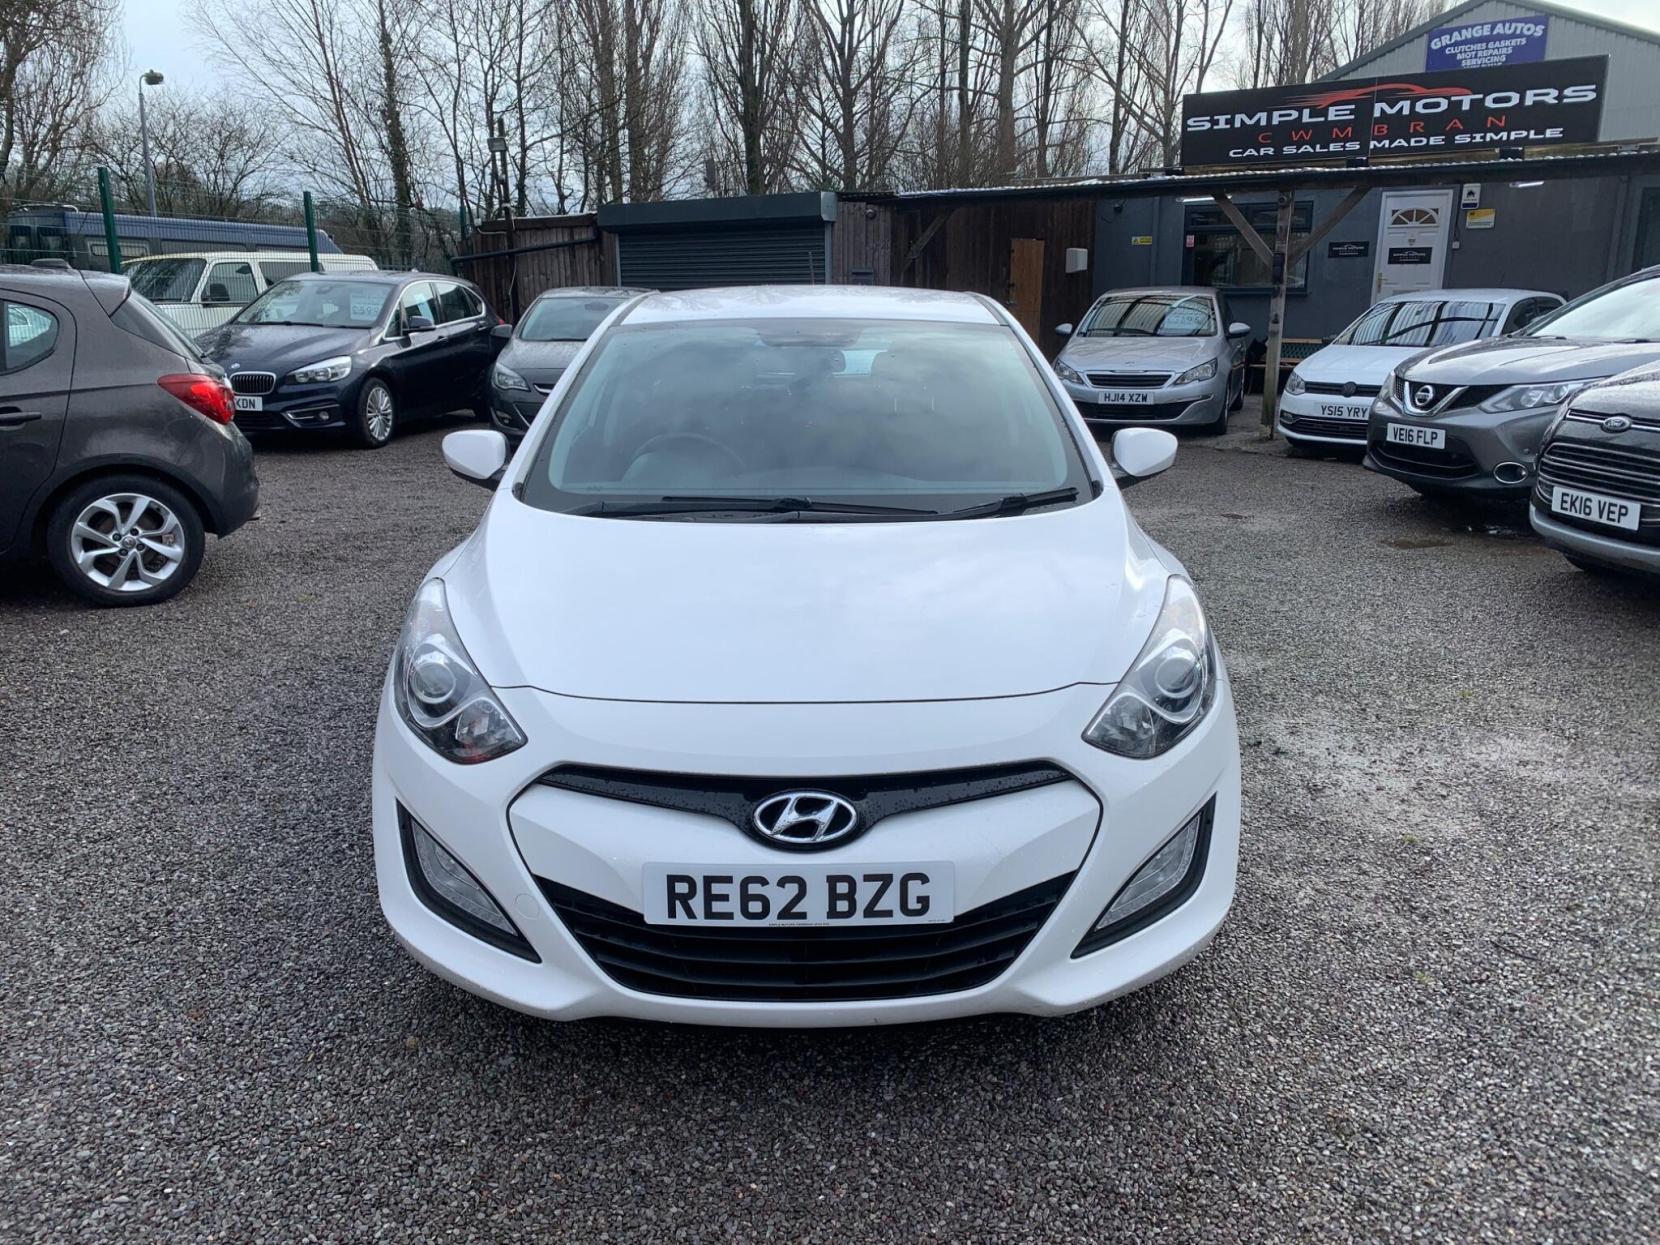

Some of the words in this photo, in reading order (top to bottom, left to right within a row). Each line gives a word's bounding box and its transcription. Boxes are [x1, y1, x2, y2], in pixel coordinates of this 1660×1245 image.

[1430, 24, 1491, 50] GRANGE
[1493, 22, 1546, 37] AUTOS
[1446, 42, 1486, 54] CLUTCHES
[1488, 38, 1527, 48] GASKETS
[1456, 52, 1476, 60] MOT
[1478, 46, 1513, 58] REPAIRS
[1461, 54, 1506, 67] SERVICING
[1186, 104, 1356, 132] SIMPLE
[1374, 84, 1597, 118] MOTORS
[1258, 114, 1506, 144] CWMBRAN
[1229, 146, 1275, 158] CAR
[1282, 141, 1361, 155] SALES
[1370, 136, 1446, 150] MADE
[1454, 128, 1564, 144] SIMPLE
[1104, 393, 1126, 402] HJ14
[1128, 393, 1148, 402] XZW
[1321, 404, 1344, 416] YS15
[1346, 406, 1368, 418] YRY
[1392, 426, 1414, 443] VE16
[1416, 429, 1438, 445] FLP
[1560, 492, 1593, 516] EK16
[1598, 500, 1629, 524] VEP
[666, 874, 808, 921] RE62
[826, 872, 931, 920] BZG
